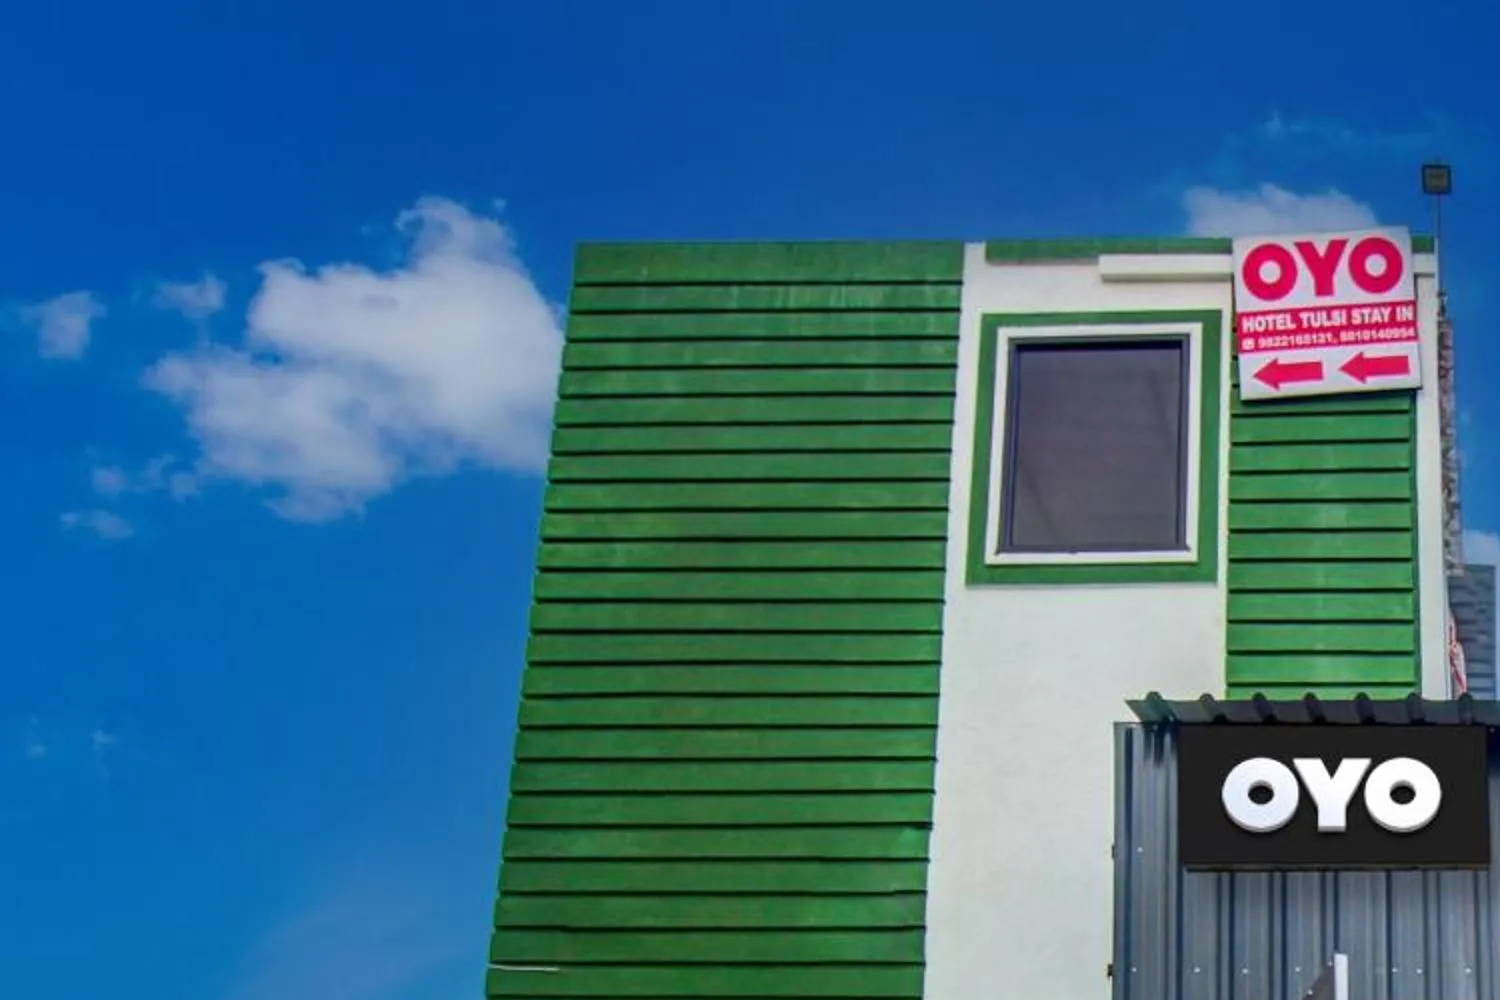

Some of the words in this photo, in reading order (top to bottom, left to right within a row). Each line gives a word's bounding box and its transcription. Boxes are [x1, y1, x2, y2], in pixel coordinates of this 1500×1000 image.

[1242, 237, 1404, 302] OYO
[1242, 314, 1296, 333] HOTEL
[1300, 311, 1347, 329] TULSI
[1351, 307, 1391, 325] STAY
[1396, 305, 1414, 321] IN
[1221, 757, 1442, 833] OYO
